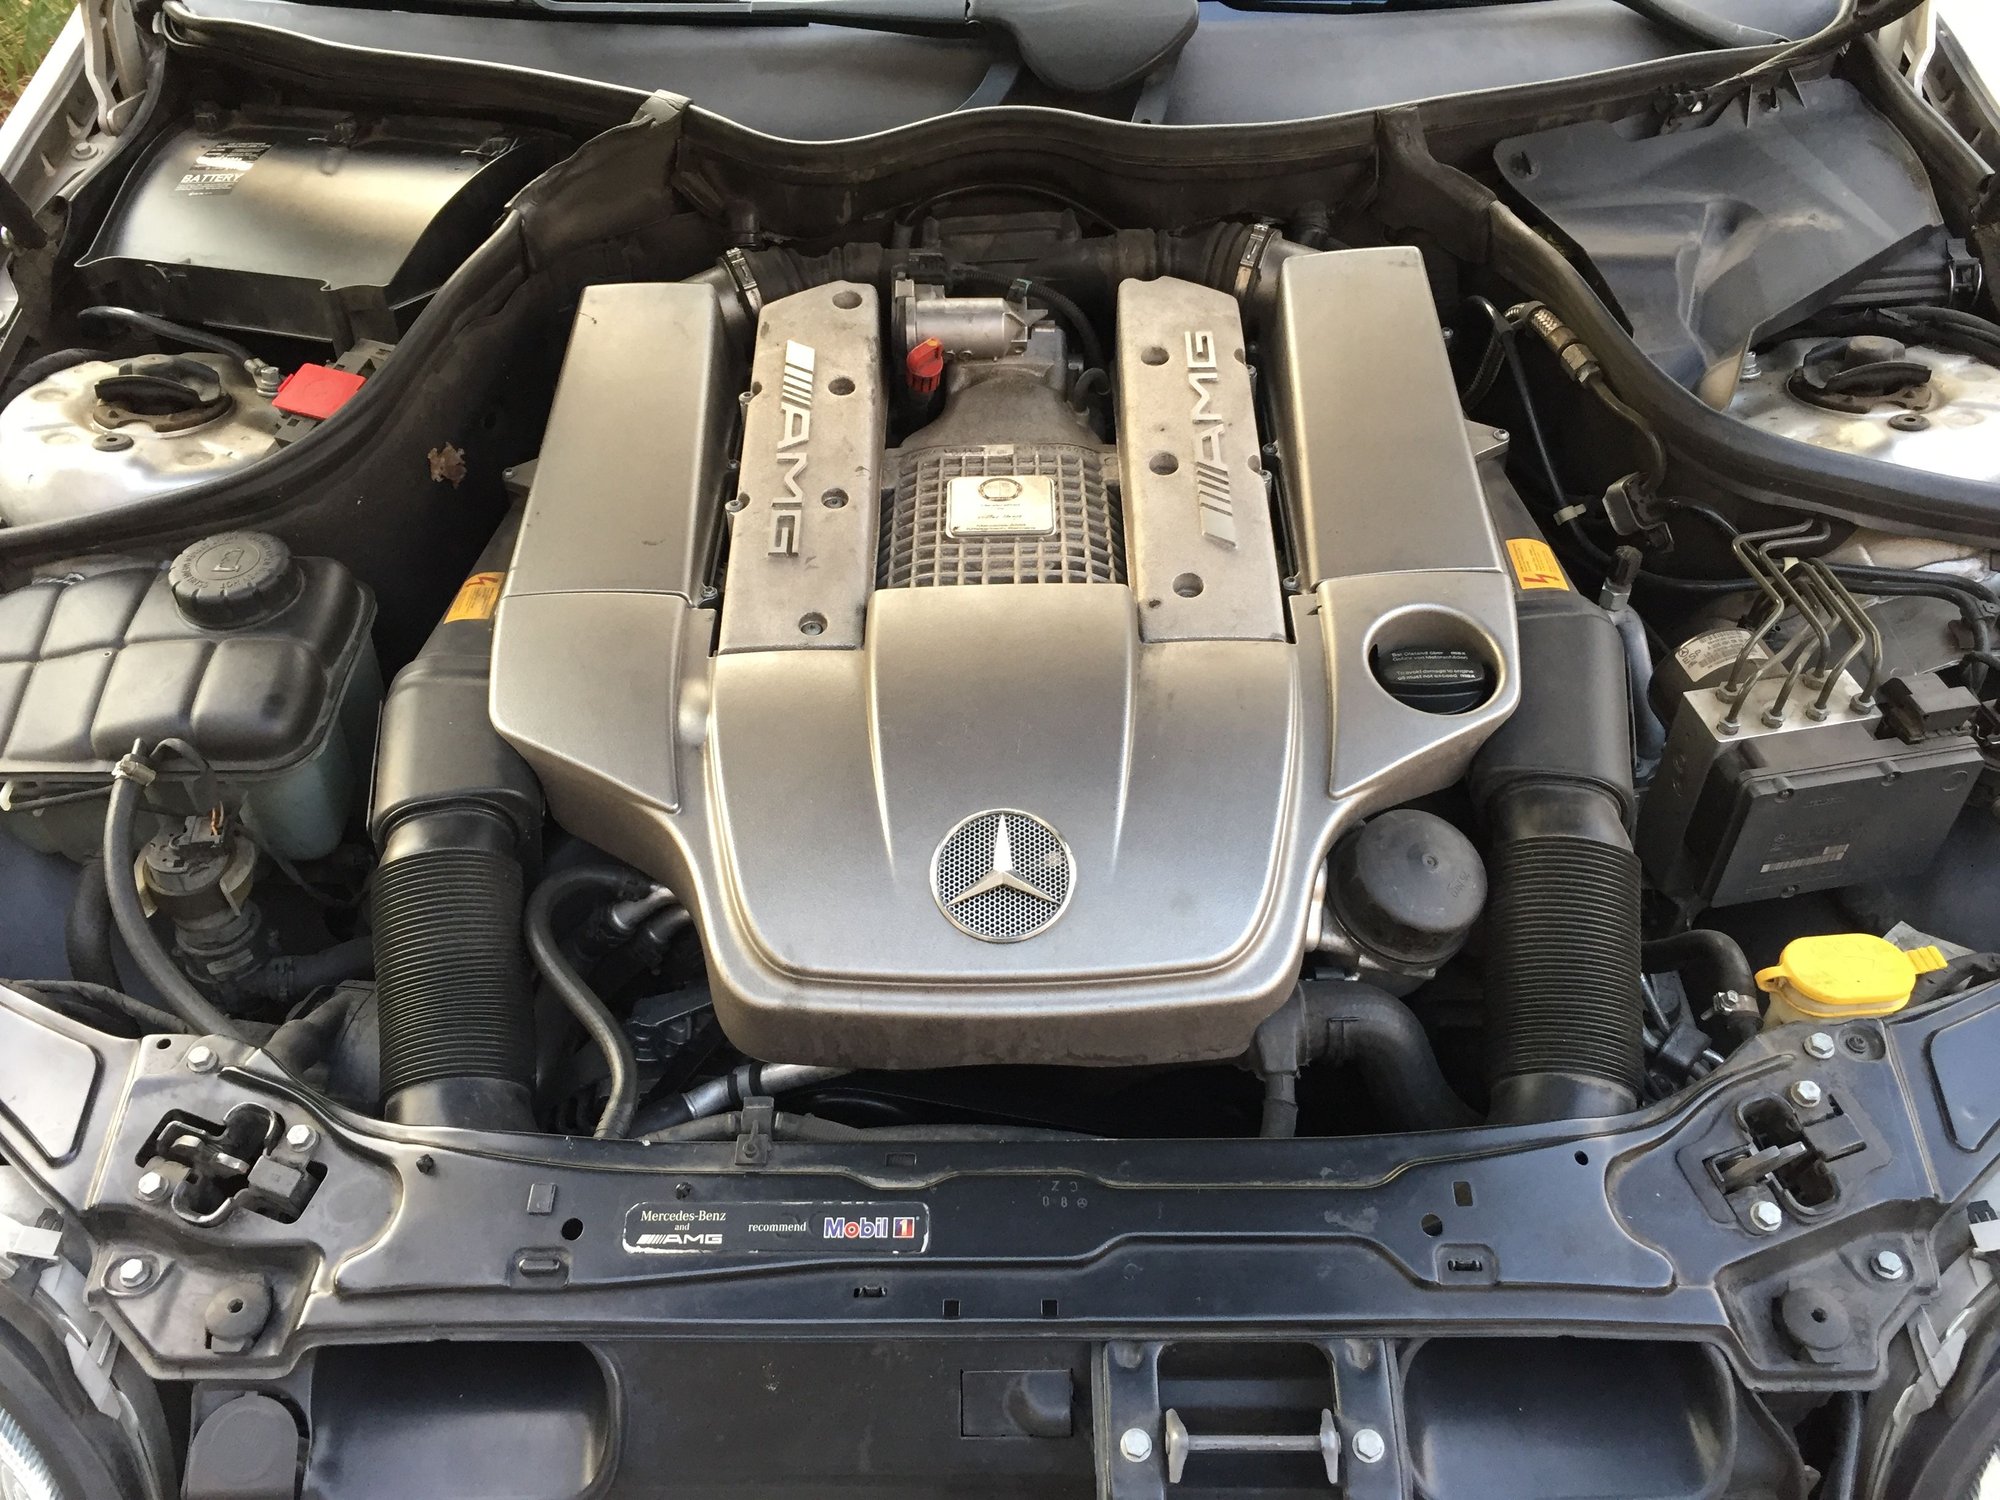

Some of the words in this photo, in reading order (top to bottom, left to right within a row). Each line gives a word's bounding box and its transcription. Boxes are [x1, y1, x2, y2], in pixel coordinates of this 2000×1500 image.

[180, 173, 245, 183] BATTERY
[767, 401, 811, 557] AMG
[640, 1210, 727, 1222] Mercedes-Benz
[674, 1222, 690, 1231] and
[748, 1221, 807, 1232] recommend
[823, 1216, 889, 1239] Mobil
[663, 1233, 723, 1245] AMG
